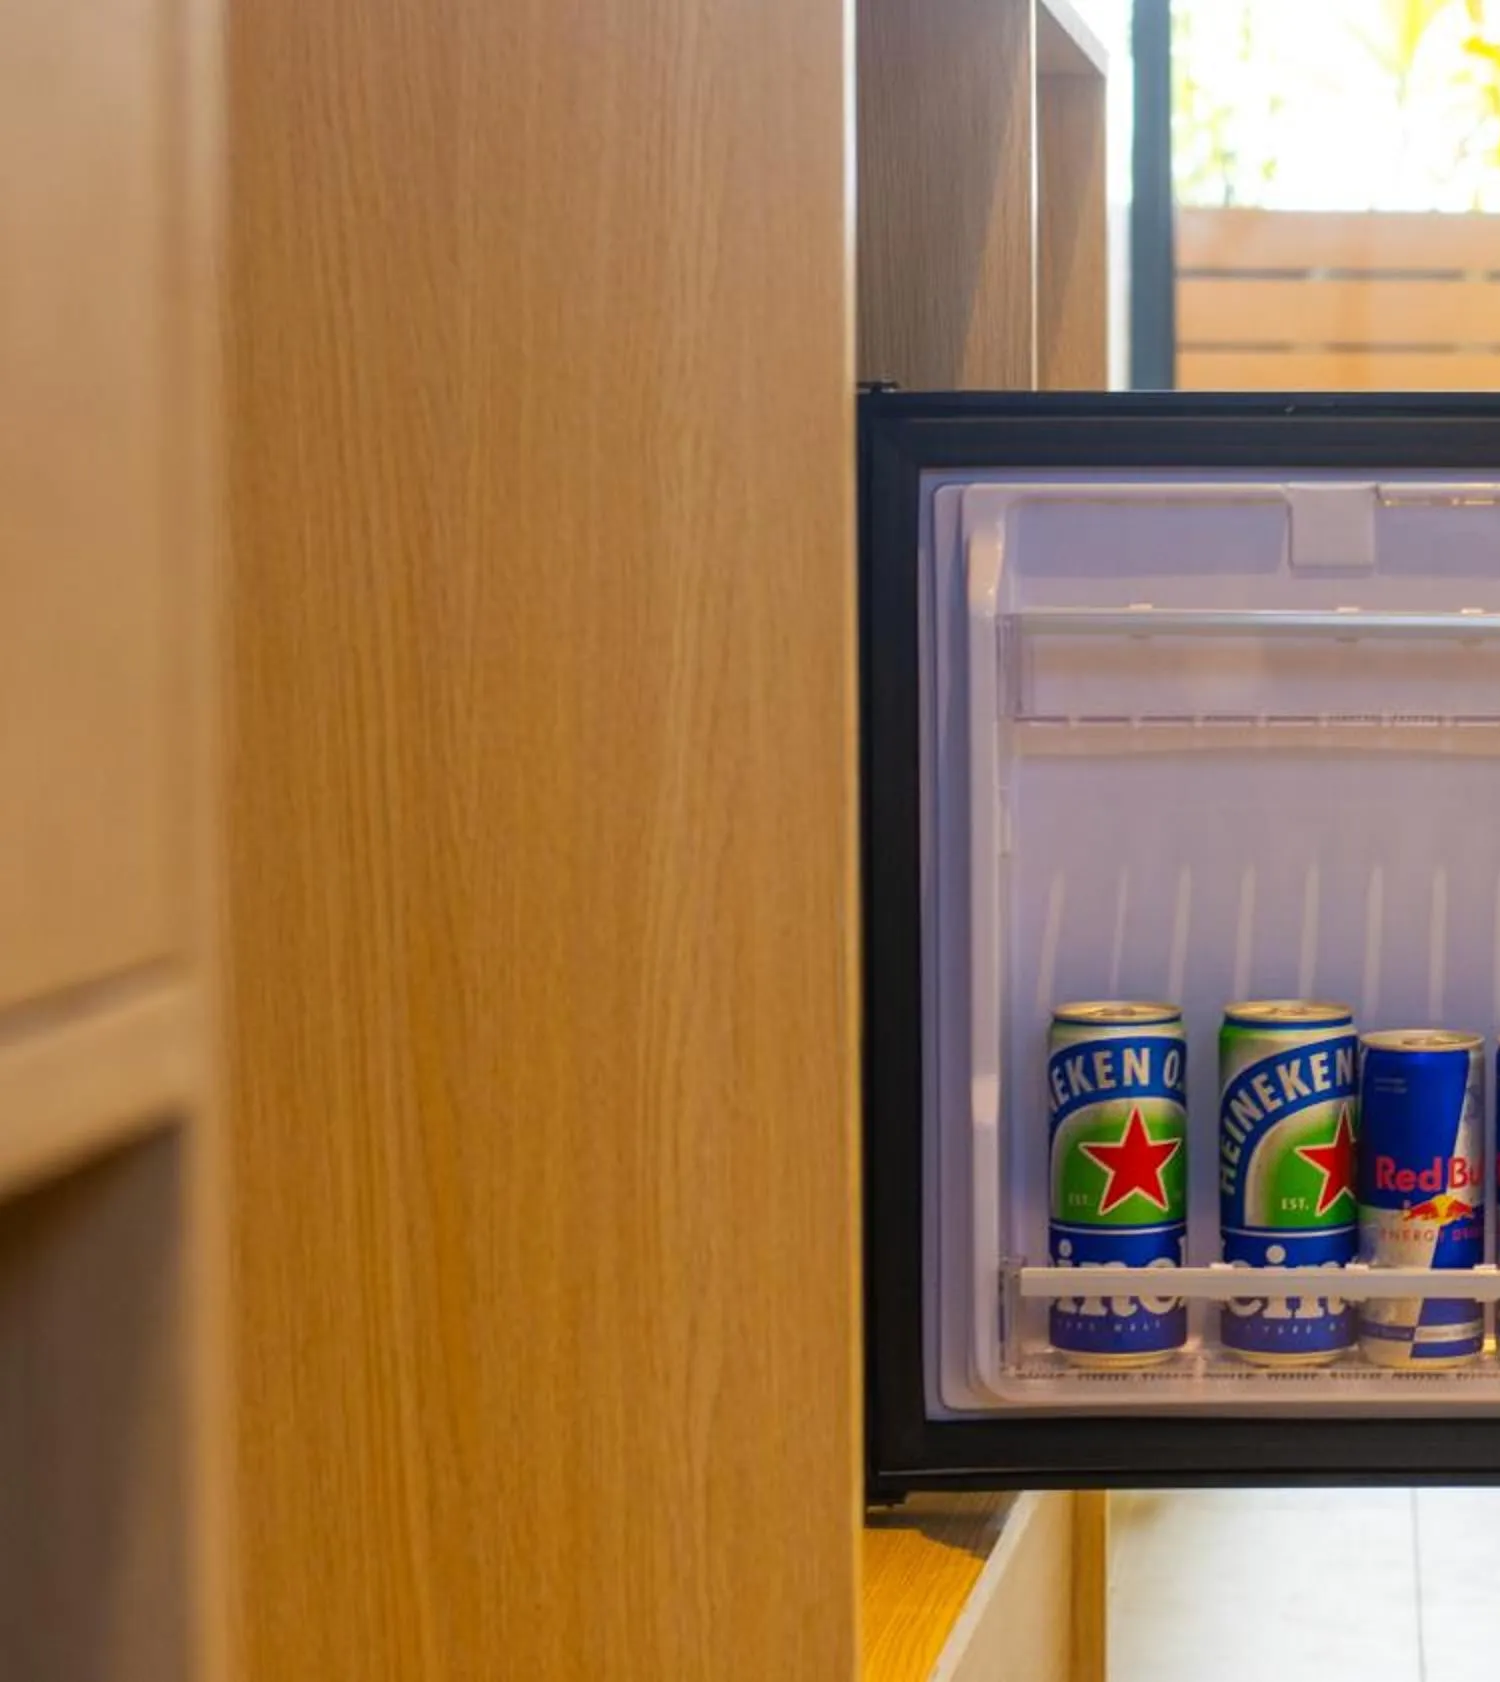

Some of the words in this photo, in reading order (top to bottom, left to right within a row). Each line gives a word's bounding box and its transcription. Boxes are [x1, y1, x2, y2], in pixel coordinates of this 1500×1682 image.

[1220, 1046, 1353, 1195] HEINEKEN
[1375, 1156, 1443, 1192] Red
[1281, 1198, 1309, 1211] EST.
